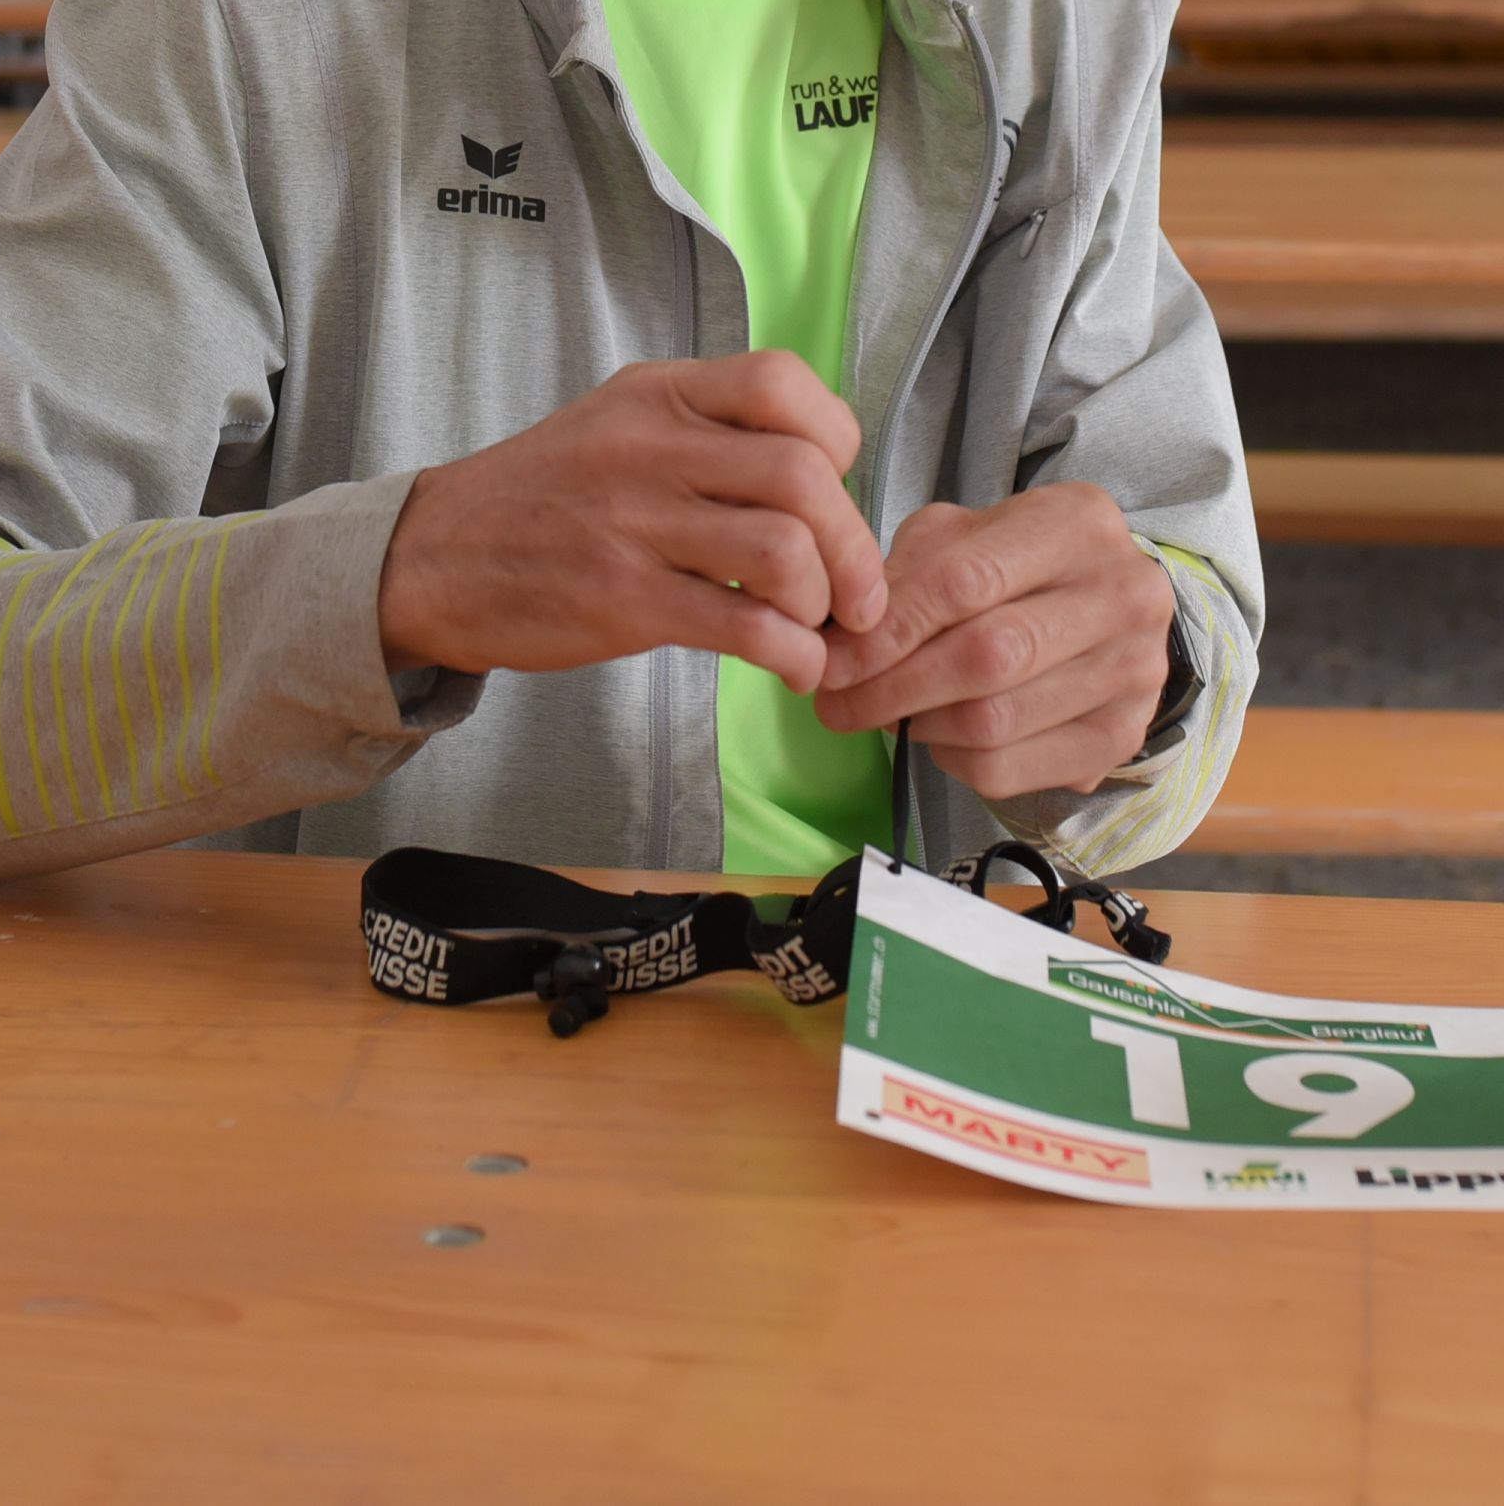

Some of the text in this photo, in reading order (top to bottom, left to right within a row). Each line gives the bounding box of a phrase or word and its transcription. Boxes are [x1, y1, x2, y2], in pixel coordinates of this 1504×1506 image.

[791, 82, 825, 101] run
[828, 75, 845, 96] &
[794, 94, 875, 132] LAUF
[437, 184, 546, 223] erima
[364, 908, 449, 970] CREDIT
[602, 914, 694, 970] REDIT
[367, 943, 449, 999] UISSE
[607, 944, 698, 991] UISSE
[1067, 971, 1426, 1043] Gauschla Berglauf
[1090, 1014, 1416, 1141] 19
[903, 1094, 1129, 1171] MARTY
